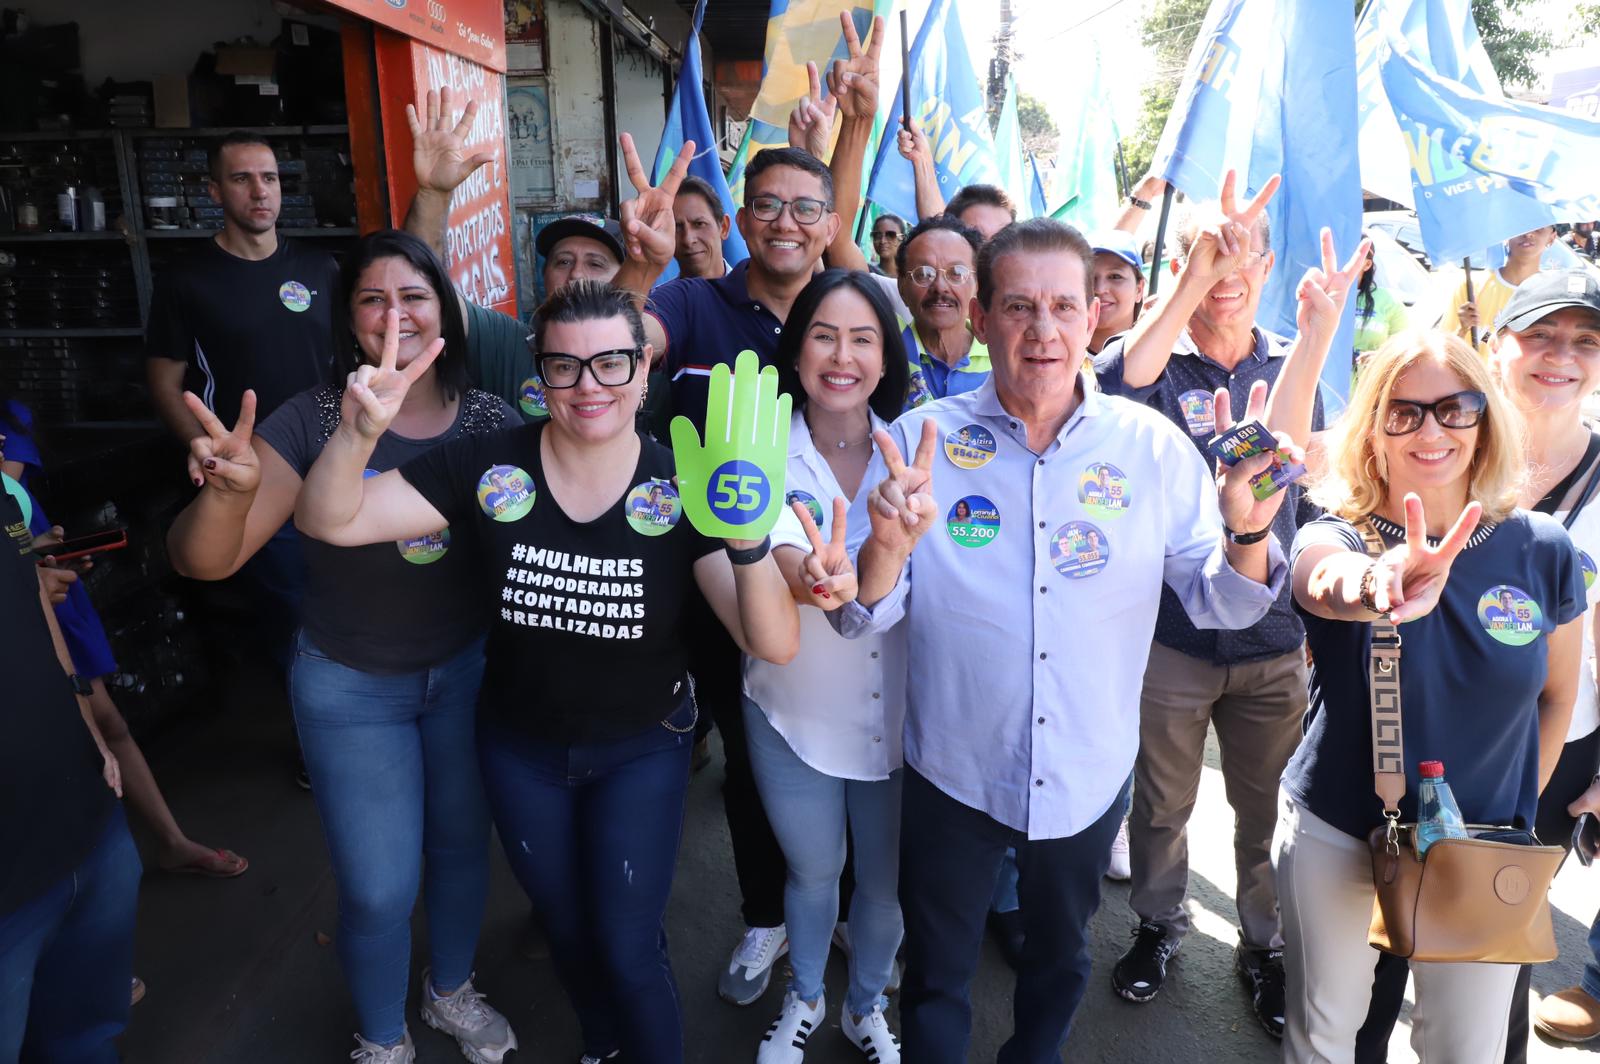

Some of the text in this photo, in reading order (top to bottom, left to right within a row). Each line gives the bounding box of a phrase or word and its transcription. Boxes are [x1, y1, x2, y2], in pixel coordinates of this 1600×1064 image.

[1444, 181, 1473, 196] VICE
[509, 478, 523, 492] 55
[714, 473, 762, 511] 55
[1111, 486, 1123, 496] 55
[659, 503, 672, 513] 55
[952, 527, 995, 538] 55.200
[511, 543, 644, 577] #MULHERES
[506, 567, 644, 597] #EMPODERADAS
[502, 586, 645, 619] #CONTADORAS
[1517, 608, 1530, 619] 55
[501, 608, 643, 639] #REALIZADAS
